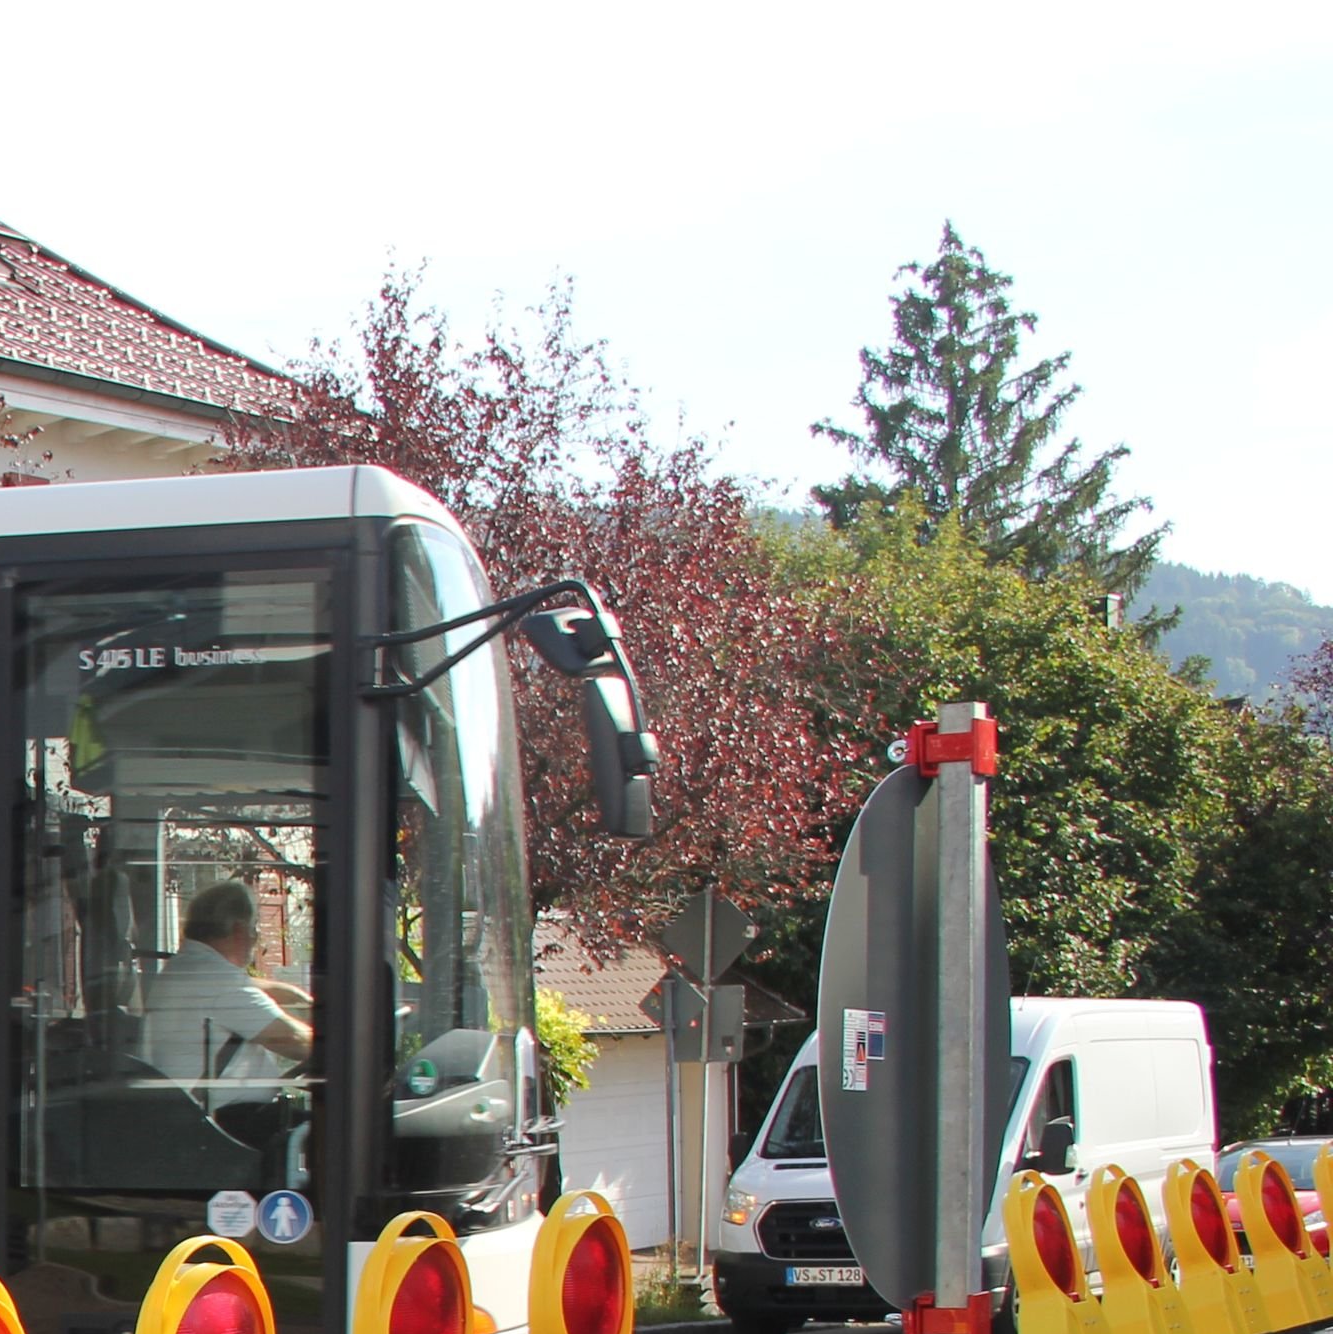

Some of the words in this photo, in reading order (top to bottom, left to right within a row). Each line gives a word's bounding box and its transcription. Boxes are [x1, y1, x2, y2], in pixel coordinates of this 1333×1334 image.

[79, 650, 94, 670] S
[134, 647, 166, 668] LE
[174, 645, 268, 666] business
[794, 1268, 810, 1282] VS
[818, 1268, 834, 1282] ST
[837, 1268, 862, 1282] 128
